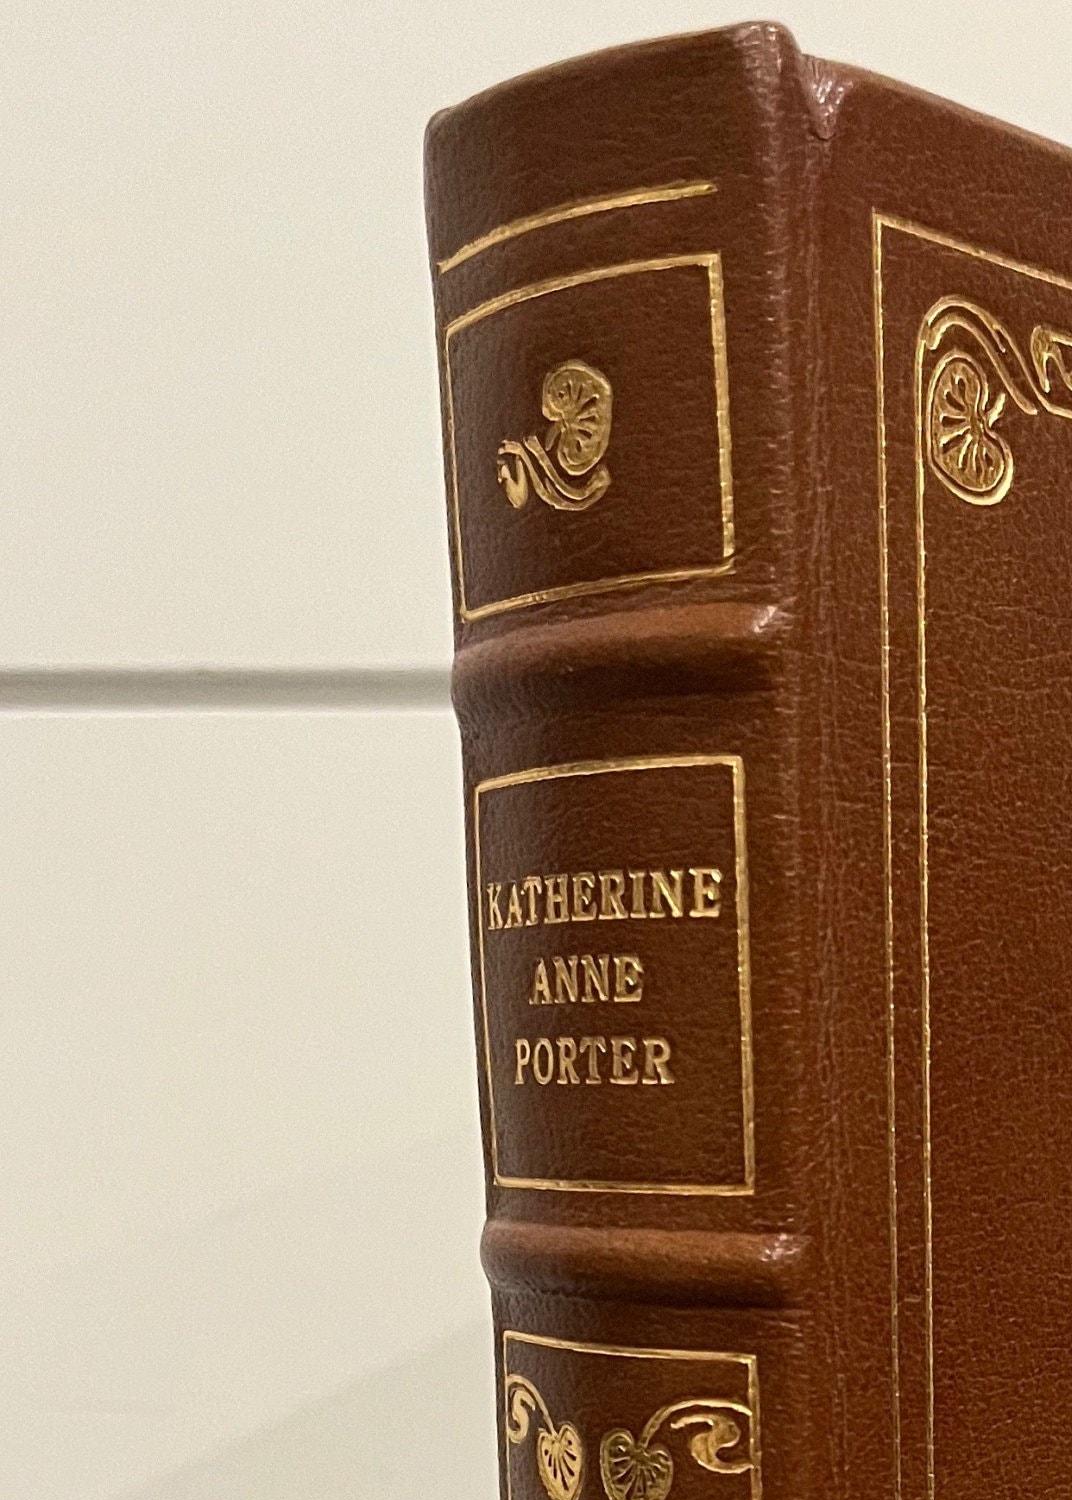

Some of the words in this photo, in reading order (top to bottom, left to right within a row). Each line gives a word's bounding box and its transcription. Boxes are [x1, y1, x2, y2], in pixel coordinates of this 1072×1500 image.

[486, 868, 723, 931] KATHERINE
[528, 953, 645, 1005] ANNE
[513, 1036, 676, 1086] PORTER
